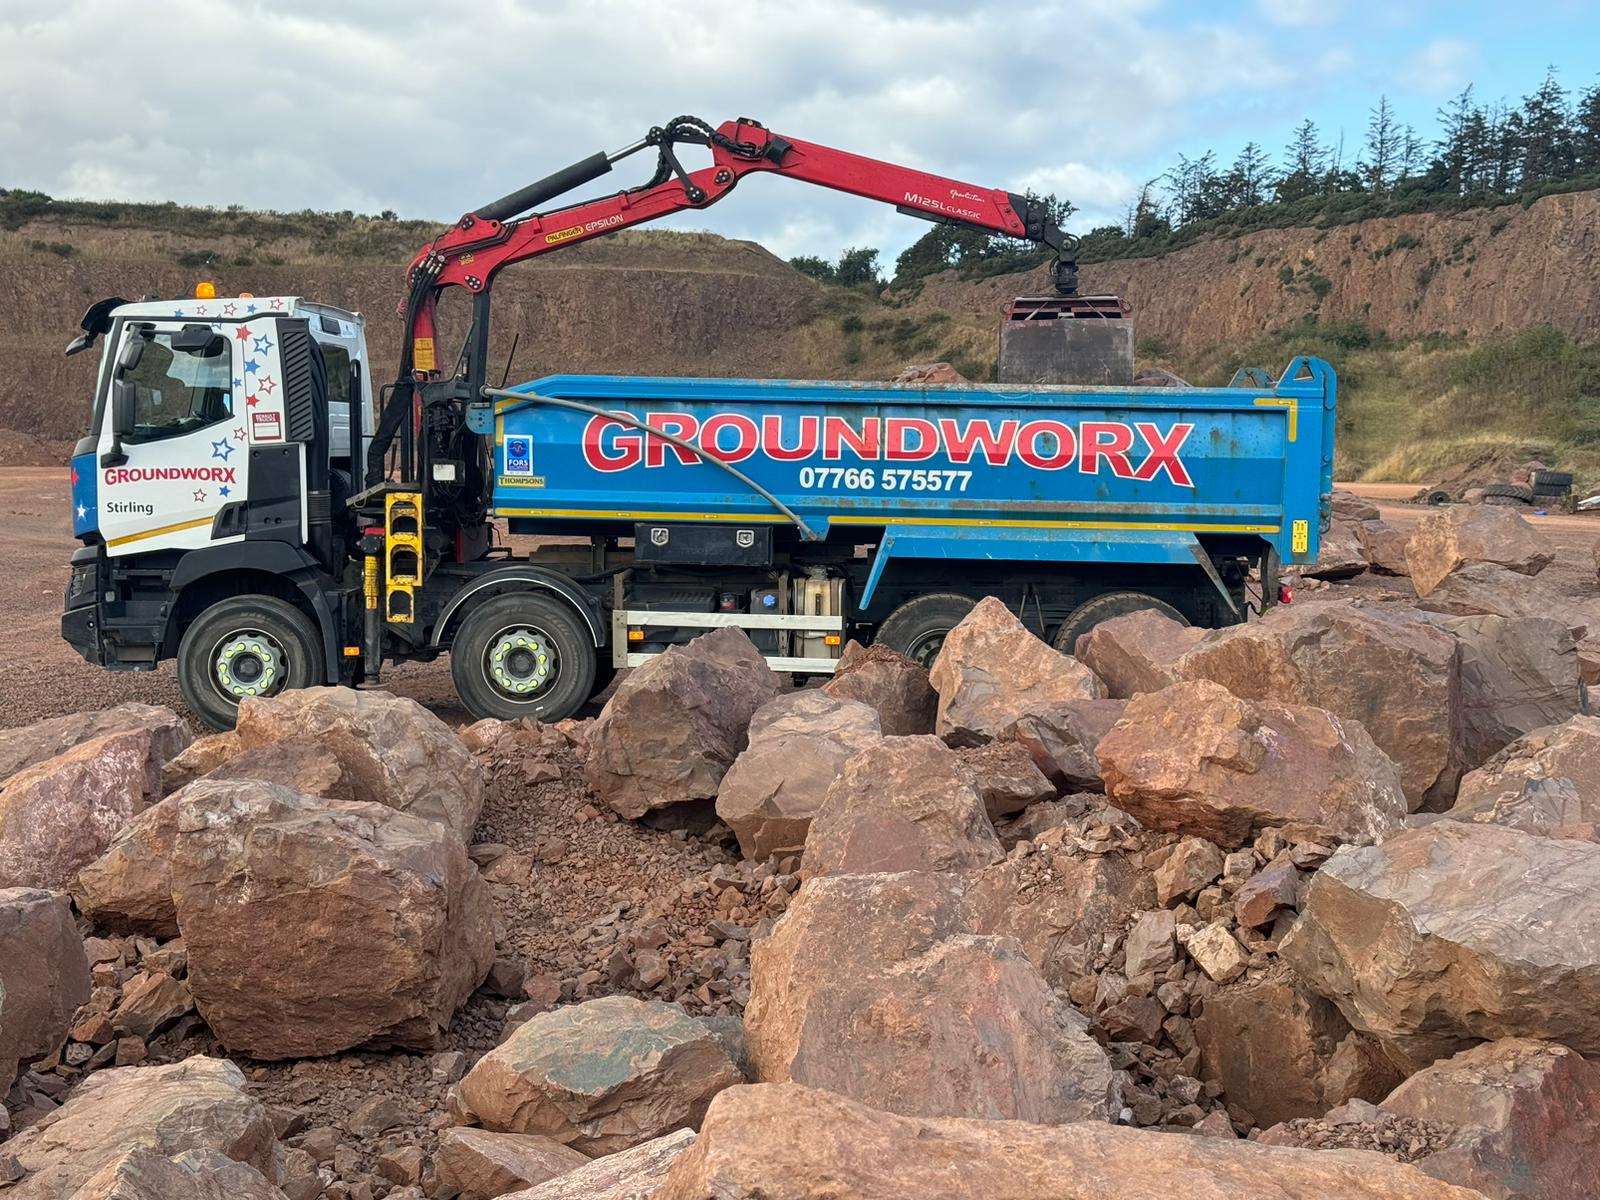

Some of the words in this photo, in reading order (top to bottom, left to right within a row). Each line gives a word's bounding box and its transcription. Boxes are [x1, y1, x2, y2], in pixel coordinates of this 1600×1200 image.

[946, 205, 981, 219] CLASSIC
[547, 226, 582, 242] PALFINGER
[585, 214, 624, 232] EPSILON
[581, 410, 1196, 489] GROUNDWORX
[104, 467, 236, 486] GROUNDWORX
[499, 477, 544, 485] THOMPSONS
[799, 467, 875, 489] 07766
[881, 468, 972, 492] 575577
[106, 501, 154, 515] Stirling
